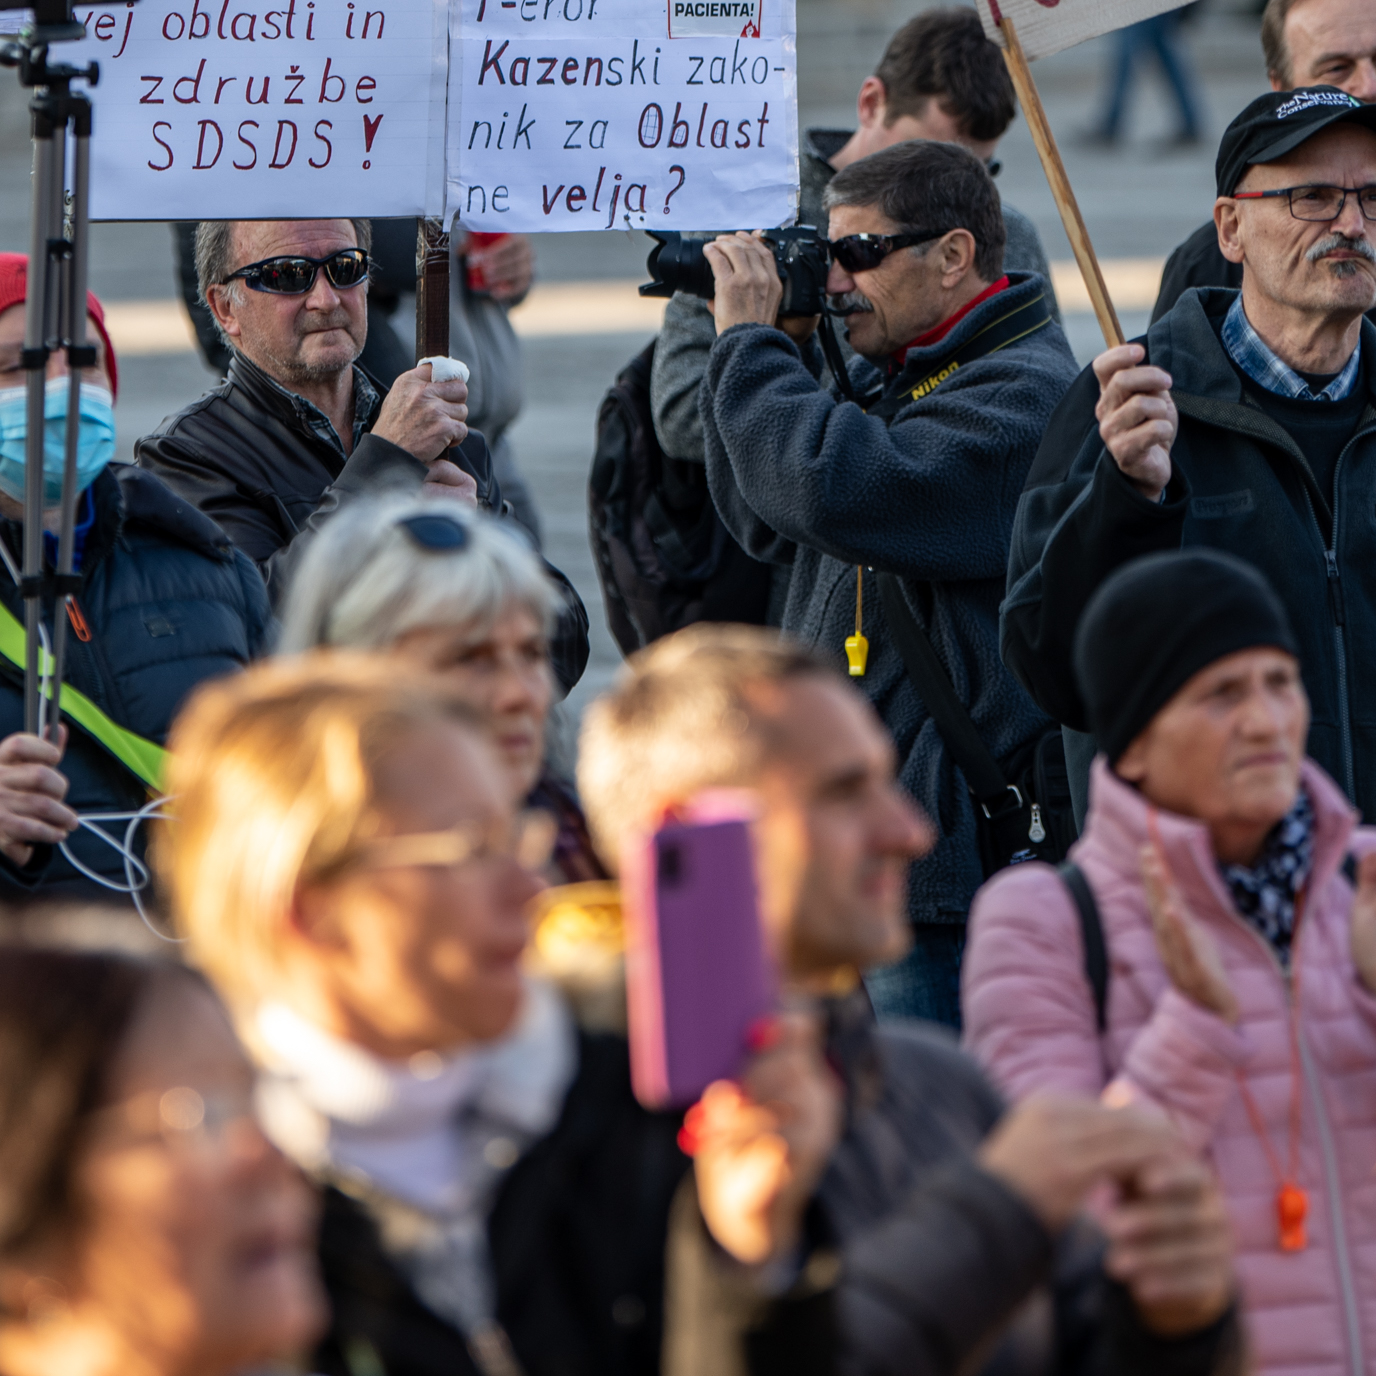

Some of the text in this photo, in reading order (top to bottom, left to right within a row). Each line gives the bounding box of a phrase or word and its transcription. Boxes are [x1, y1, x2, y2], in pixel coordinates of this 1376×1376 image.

[345, 2, 385, 39] in
[675, 2, 754, 18] PACIENTA!
[139, 58, 378, 105] združbe
[478, 39, 786, 86] Kazenski zako-
[1276, 91, 1349, 113] The Nature
[468, 102, 769, 149] nik za Oblast
[467, 182, 510, 213] ne
[911, 361, 959, 400] Nikon
